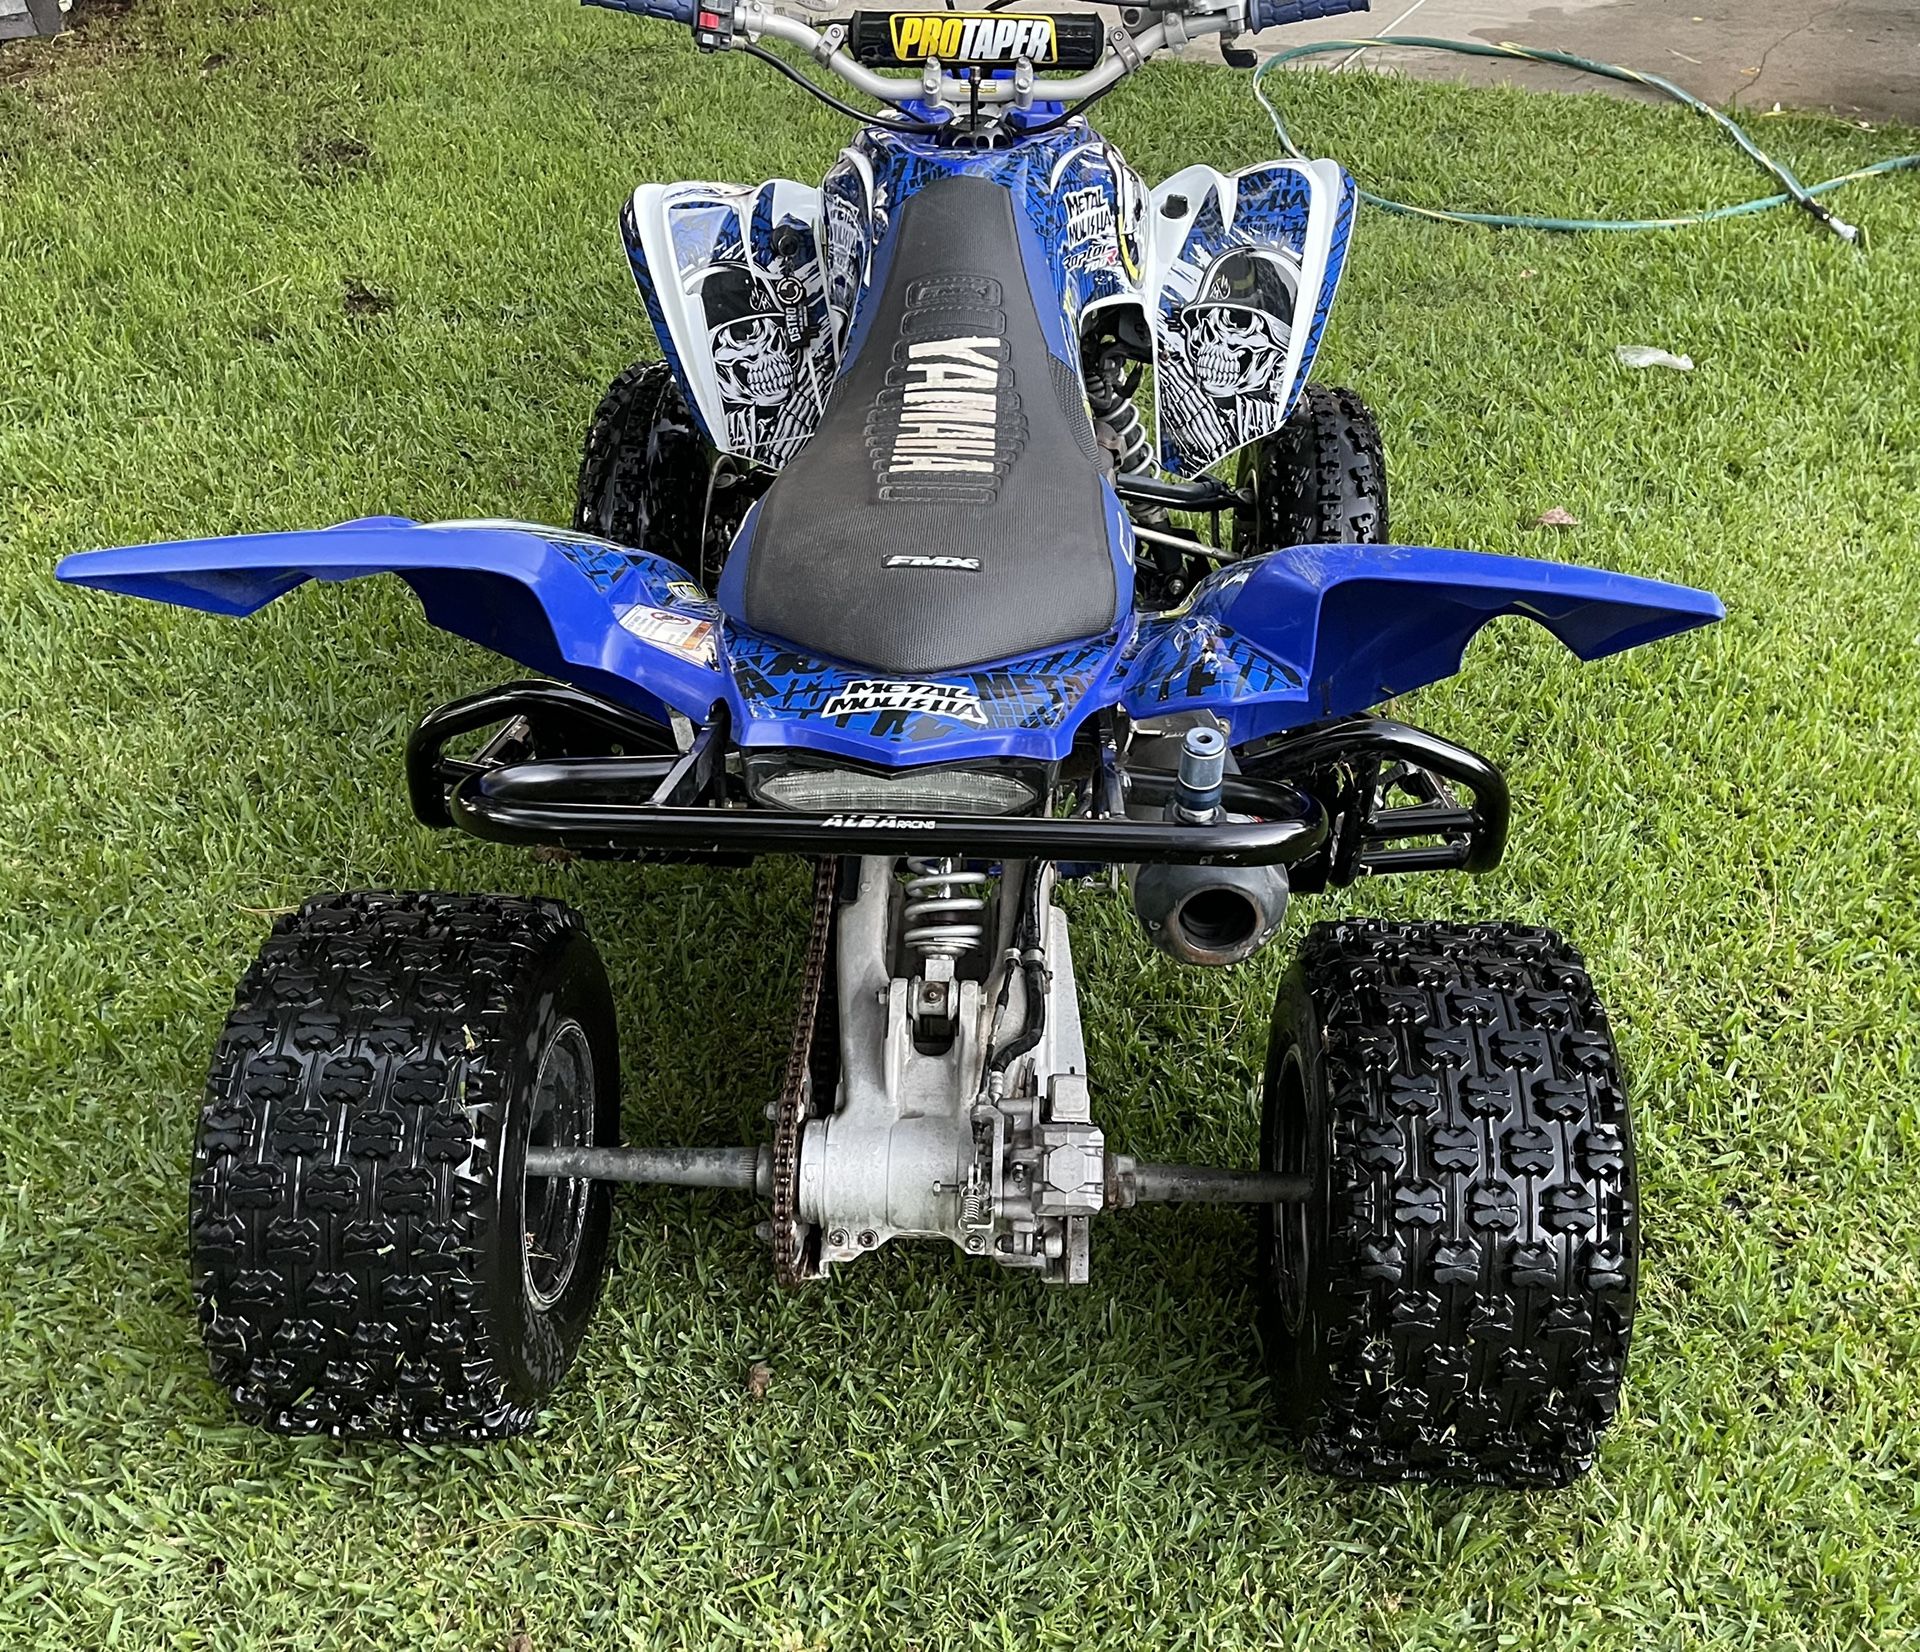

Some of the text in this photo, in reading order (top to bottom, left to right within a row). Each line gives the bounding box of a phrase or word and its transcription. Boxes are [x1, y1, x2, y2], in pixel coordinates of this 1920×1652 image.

[900, 18, 1050, 62] PROTAPER
[1065, 189, 1107, 218] METAL
[1068, 209, 1112, 245] MULISHA
[889, 335, 1001, 473] YAMAHA
[848, 682, 970, 699] METAL
[827, 696, 982, 720] MULISHA
[821, 814, 897, 829] ALBA
